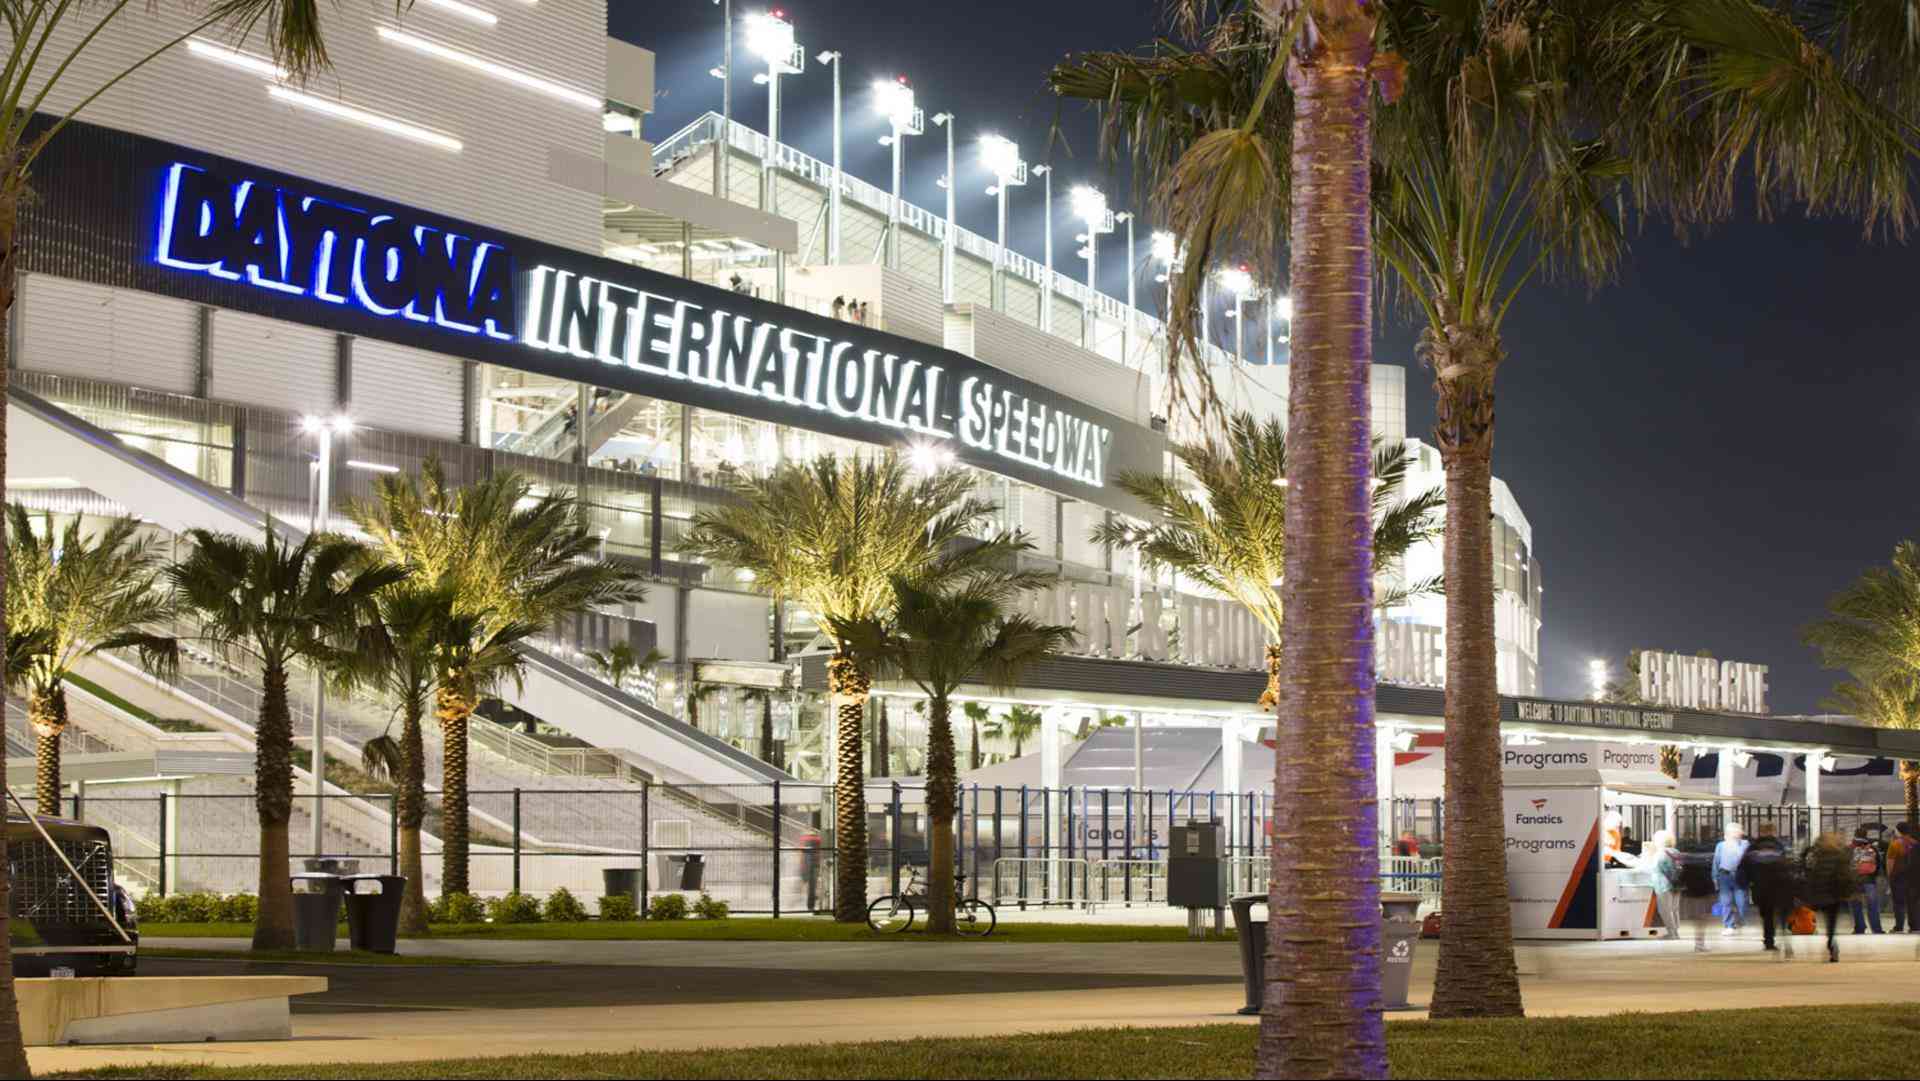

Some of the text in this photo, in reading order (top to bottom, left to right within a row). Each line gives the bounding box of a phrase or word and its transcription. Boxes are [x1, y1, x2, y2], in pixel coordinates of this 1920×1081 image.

[158, 163, 1111, 488] DAYTONA INTERNATIONAL SPEEDWAY
[1640, 651, 1769, 714] CENTER GATE
[1518, 702, 1553, 721] WELCOME
[1504, 751, 1588, 769] Programs
[1603, 749, 1655, 768] Programs
[1516, 814, 1563, 824] Fanatics
[1506, 837, 1576, 853] Programs
